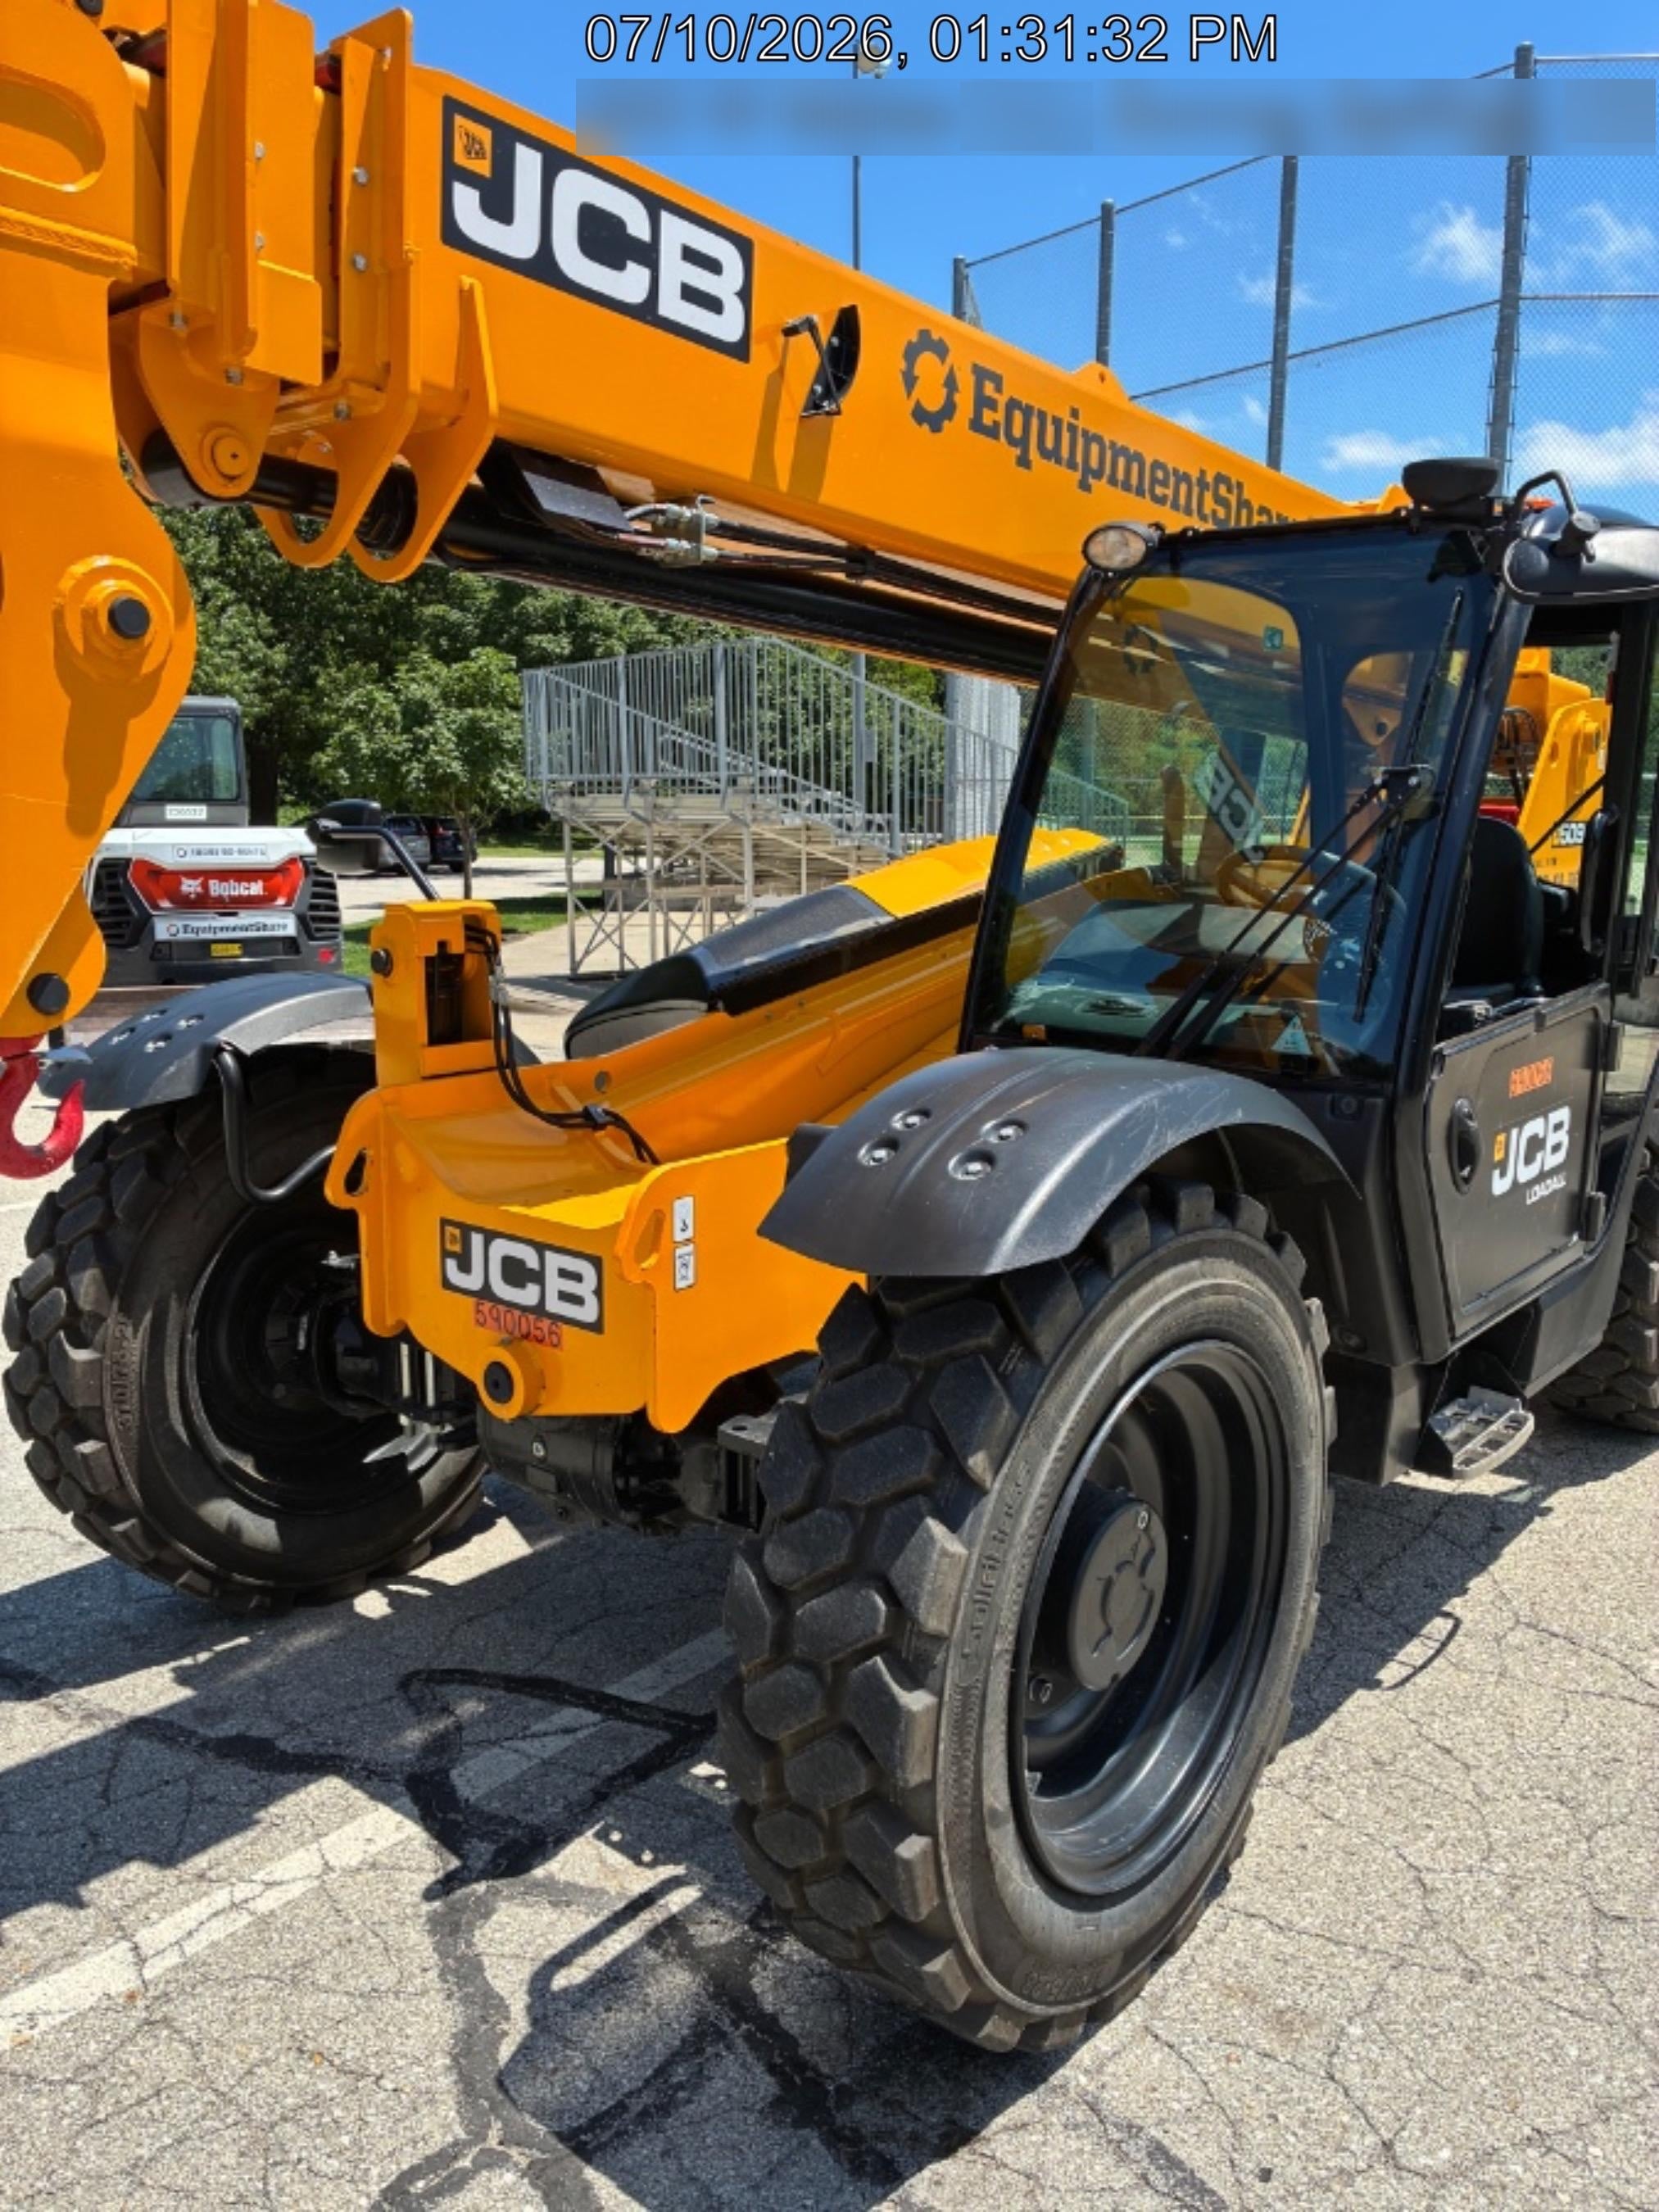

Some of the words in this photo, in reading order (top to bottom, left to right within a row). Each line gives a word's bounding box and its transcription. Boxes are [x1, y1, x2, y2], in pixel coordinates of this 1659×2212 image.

[452, 141, 745, 342] JCB
[207, 877, 264, 898] Bobcat
[1491, 1105, 1571, 1196] JCB
[445, 1231, 600, 1324] JCB
[475, 1300, 562, 1349] 590056
